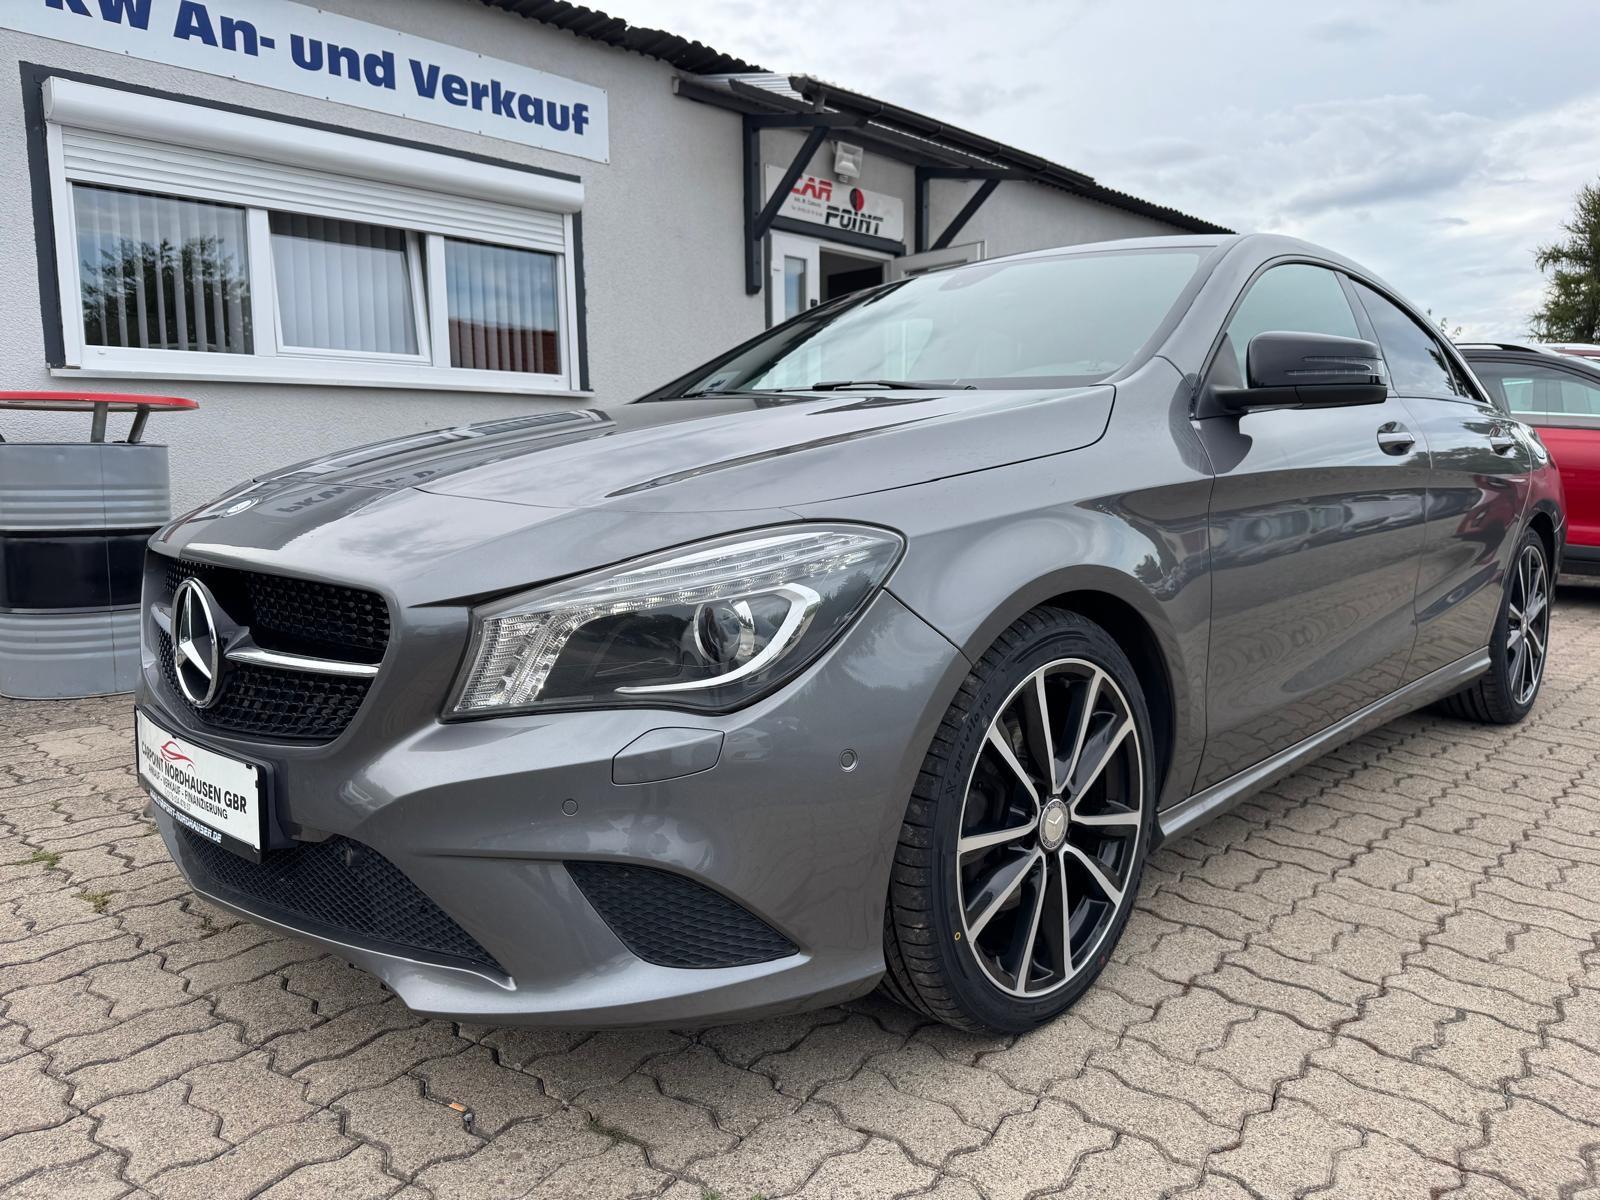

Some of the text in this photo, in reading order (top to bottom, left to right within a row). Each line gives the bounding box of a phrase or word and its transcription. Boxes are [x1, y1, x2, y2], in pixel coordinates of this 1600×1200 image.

[173, 0, 275, 57] An-
[291, 33, 395, 90] und
[409, 58, 590, 136] Verkauf
[825, 205, 883, 235] POINT
[141, 741, 164, 773] CARPOINT
[164, 762, 222, 804] NORDHAUSEN
[224, 790, 247, 814] GBR
[185, 792, 228, 819] FINANZIERUNG
